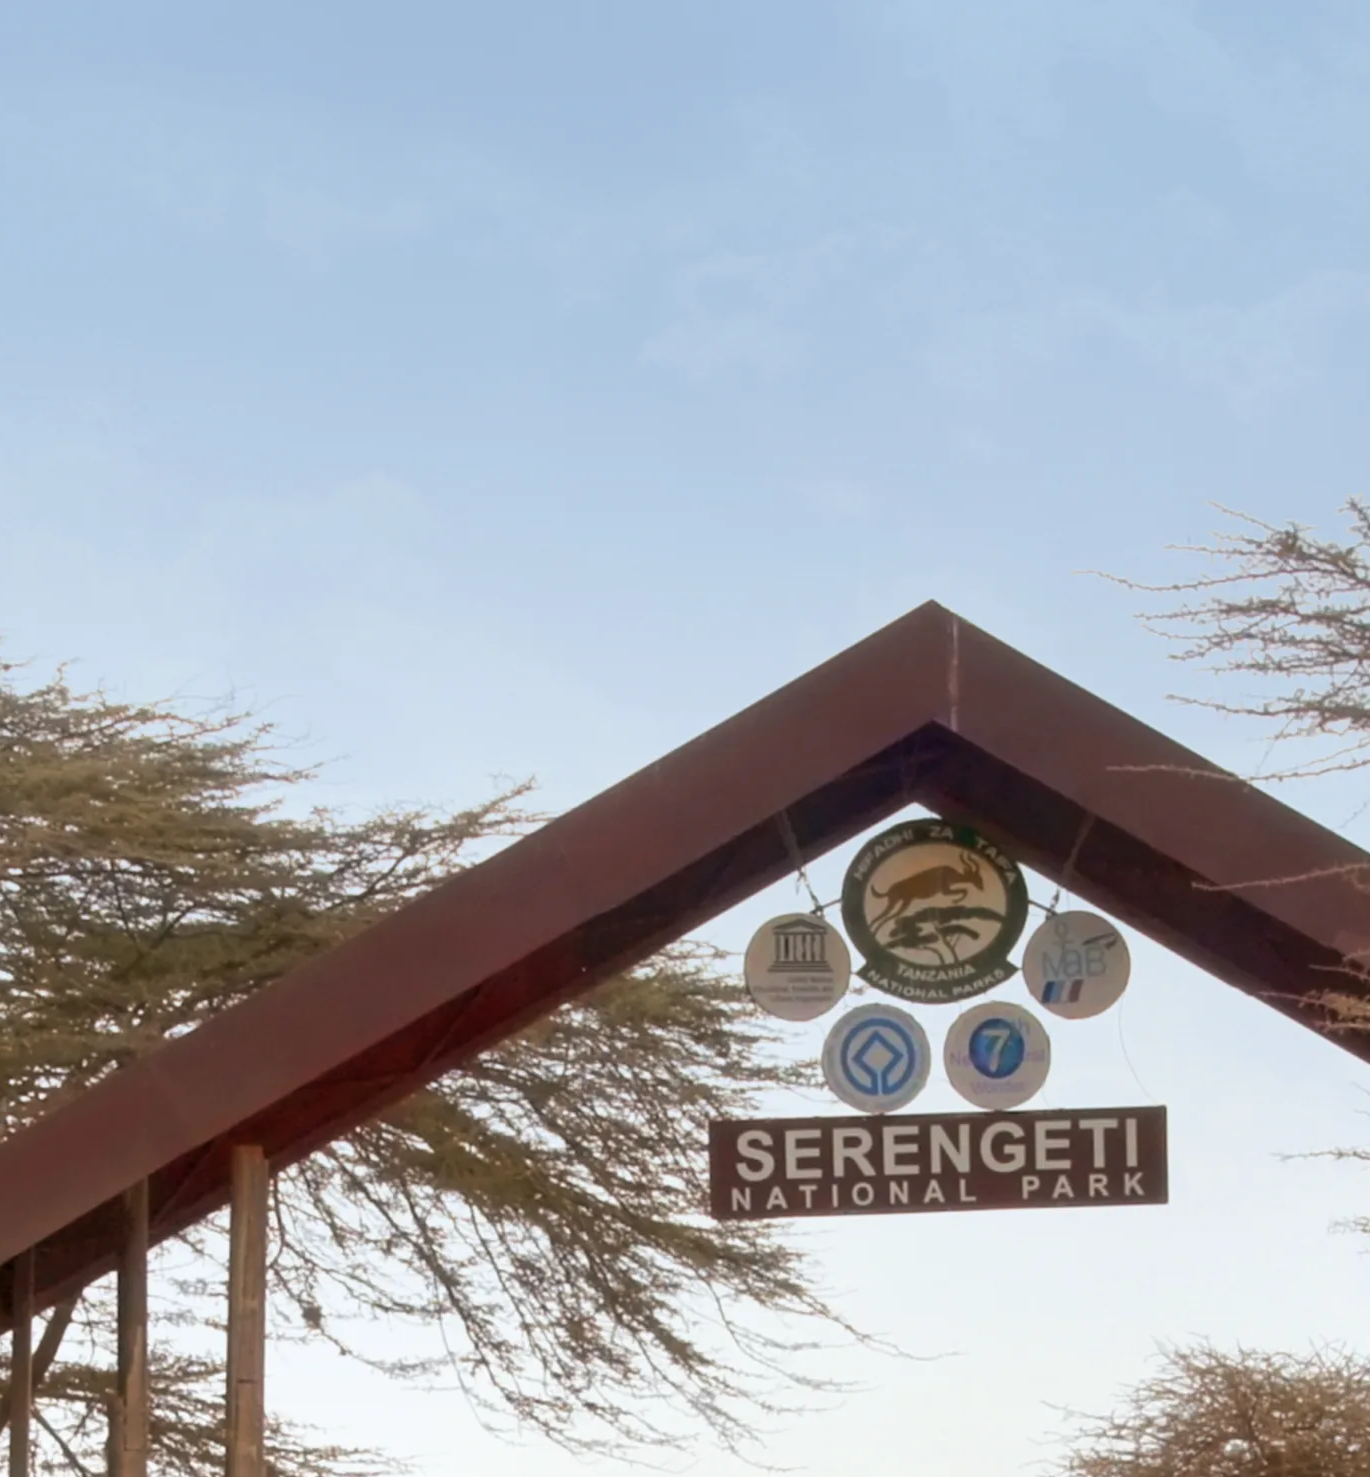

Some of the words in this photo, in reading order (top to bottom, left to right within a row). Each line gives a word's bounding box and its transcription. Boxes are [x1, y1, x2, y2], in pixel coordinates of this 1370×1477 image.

[928, 825, 955, 841] ZA
[866, 969, 948, 998] NATIONAL
[952, 968, 1005, 997] PARKS
[896, 963, 977, 982] TANZANIA
[735, 1118, 1138, 1182] SERENGETI
[731, 1178, 977, 1212] NATIONAL
[1021, 1172, 1146, 1200] PARK
